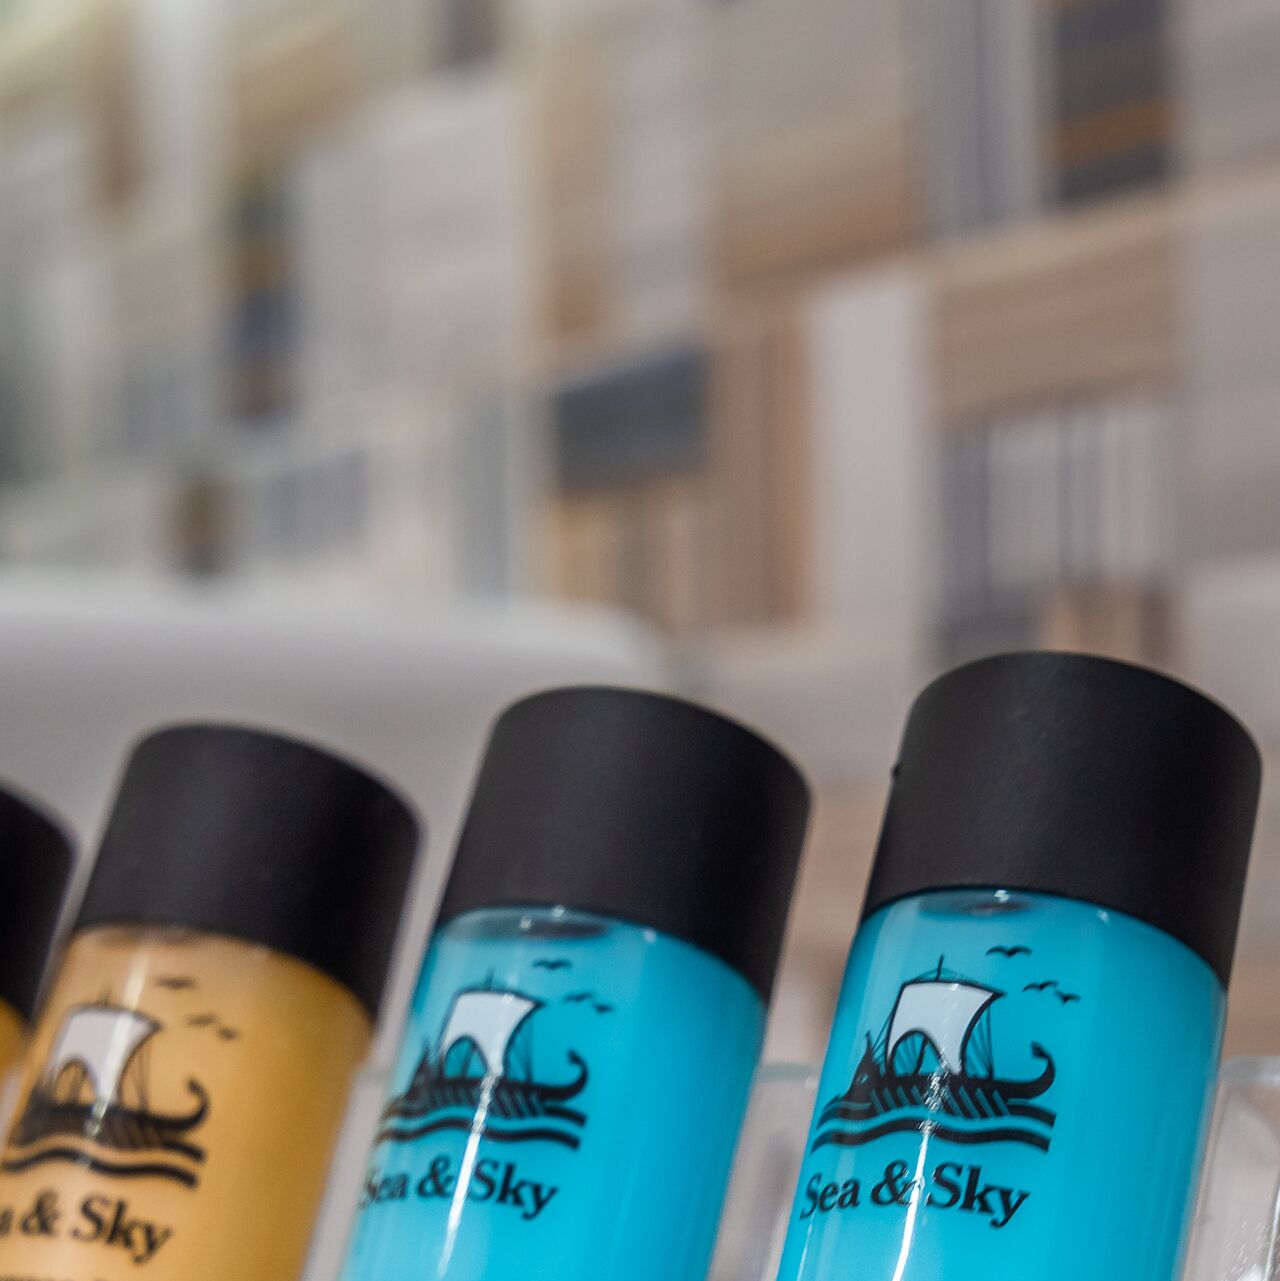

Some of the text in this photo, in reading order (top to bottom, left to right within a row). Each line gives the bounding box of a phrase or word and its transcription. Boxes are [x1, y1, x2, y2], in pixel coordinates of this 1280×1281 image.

[417, 1155, 455, 1199] &
[467, 1157, 559, 1221] Sky
[798, 1159, 1032, 1227] Sea & Sky
[19, 1188, 60, 1237] &
[72, 1194, 173, 1265] Sky
